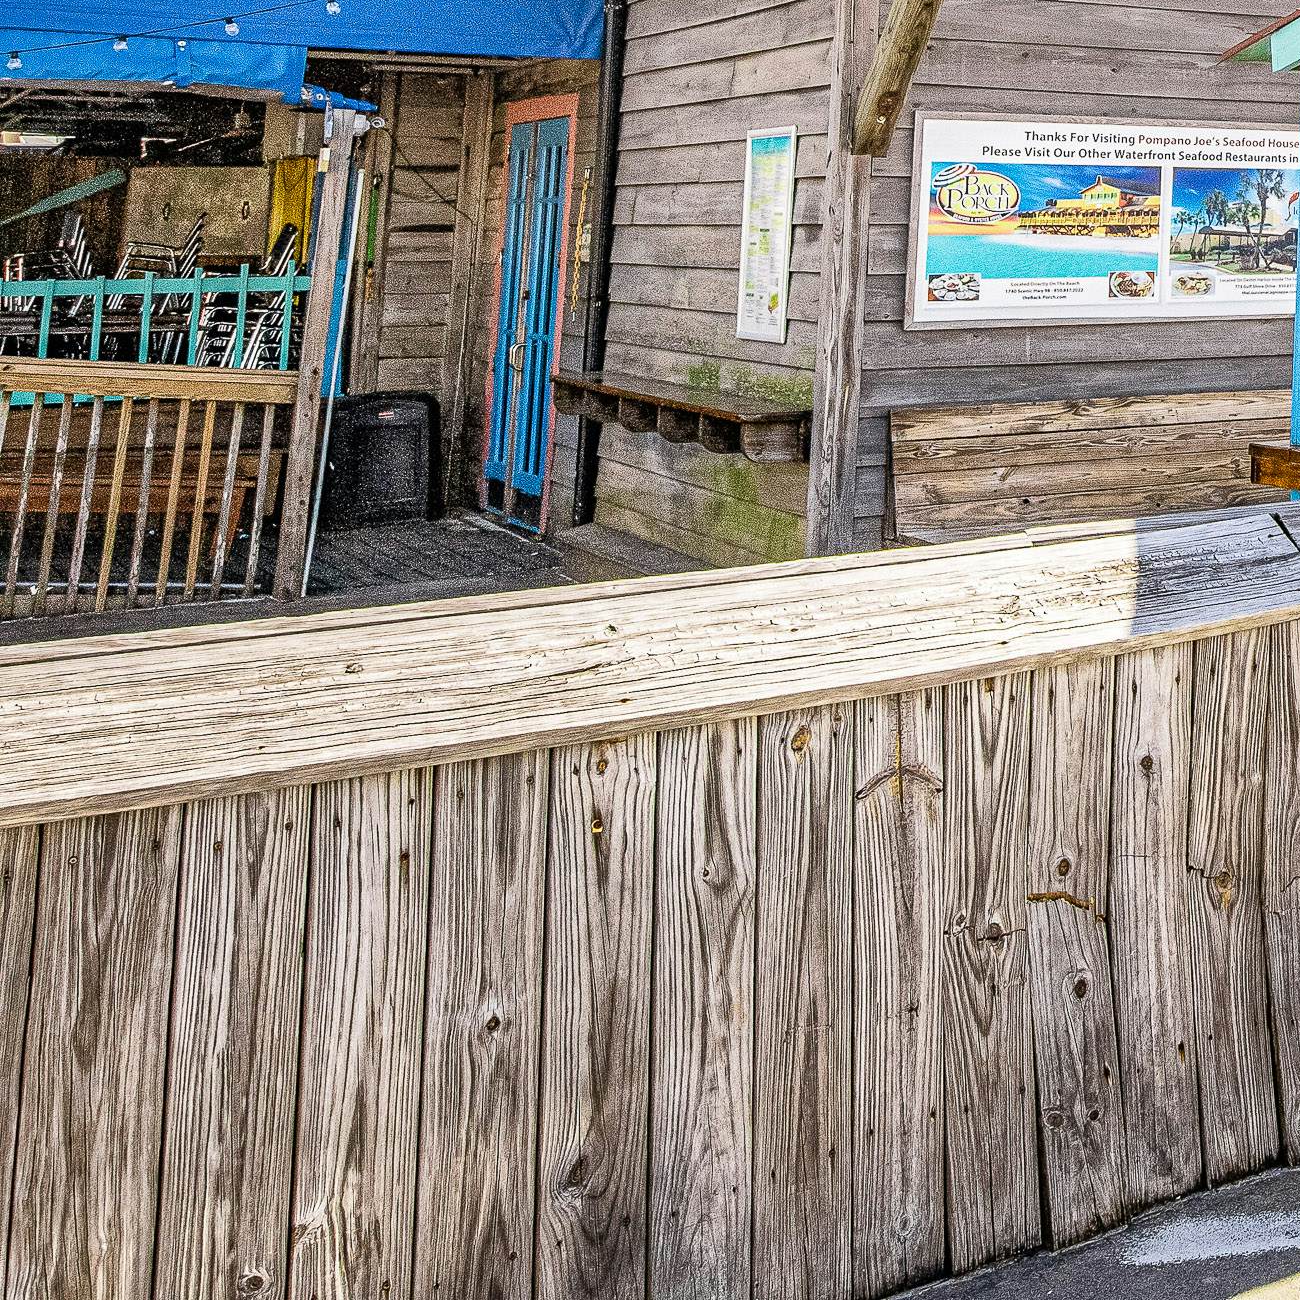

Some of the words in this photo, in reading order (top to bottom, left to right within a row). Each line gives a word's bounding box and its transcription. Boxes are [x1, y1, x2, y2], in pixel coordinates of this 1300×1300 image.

[1024, 131, 1067, 142] Thanks
[1070, 132, 1090, 143] For
[1092, 133, 1136, 147] Visiting
[1138, 134, 1192, 147] Pompano
[1194, 136, 1220, 146] Joe's
[1223, 137, 1266, 148] Seafood
[1268, 138, 1300, 149] House
[982, 145, 1022, 157] Please
[1024, 147, 1050, 158] Visit
[1053, 147, 1076, 158] Our
[1078, 148, 1112, 159] Other
[1114, 149, 1176, 161] Waterfront
[1178, 150, 1222, 162] Seafood
[1225, 152, 1287, 163] Restaurants
[1289, 153, 1299, 163] in
[964, 175, 1010, 196] BACK
[947, 188, 1009, 209] PORCH
